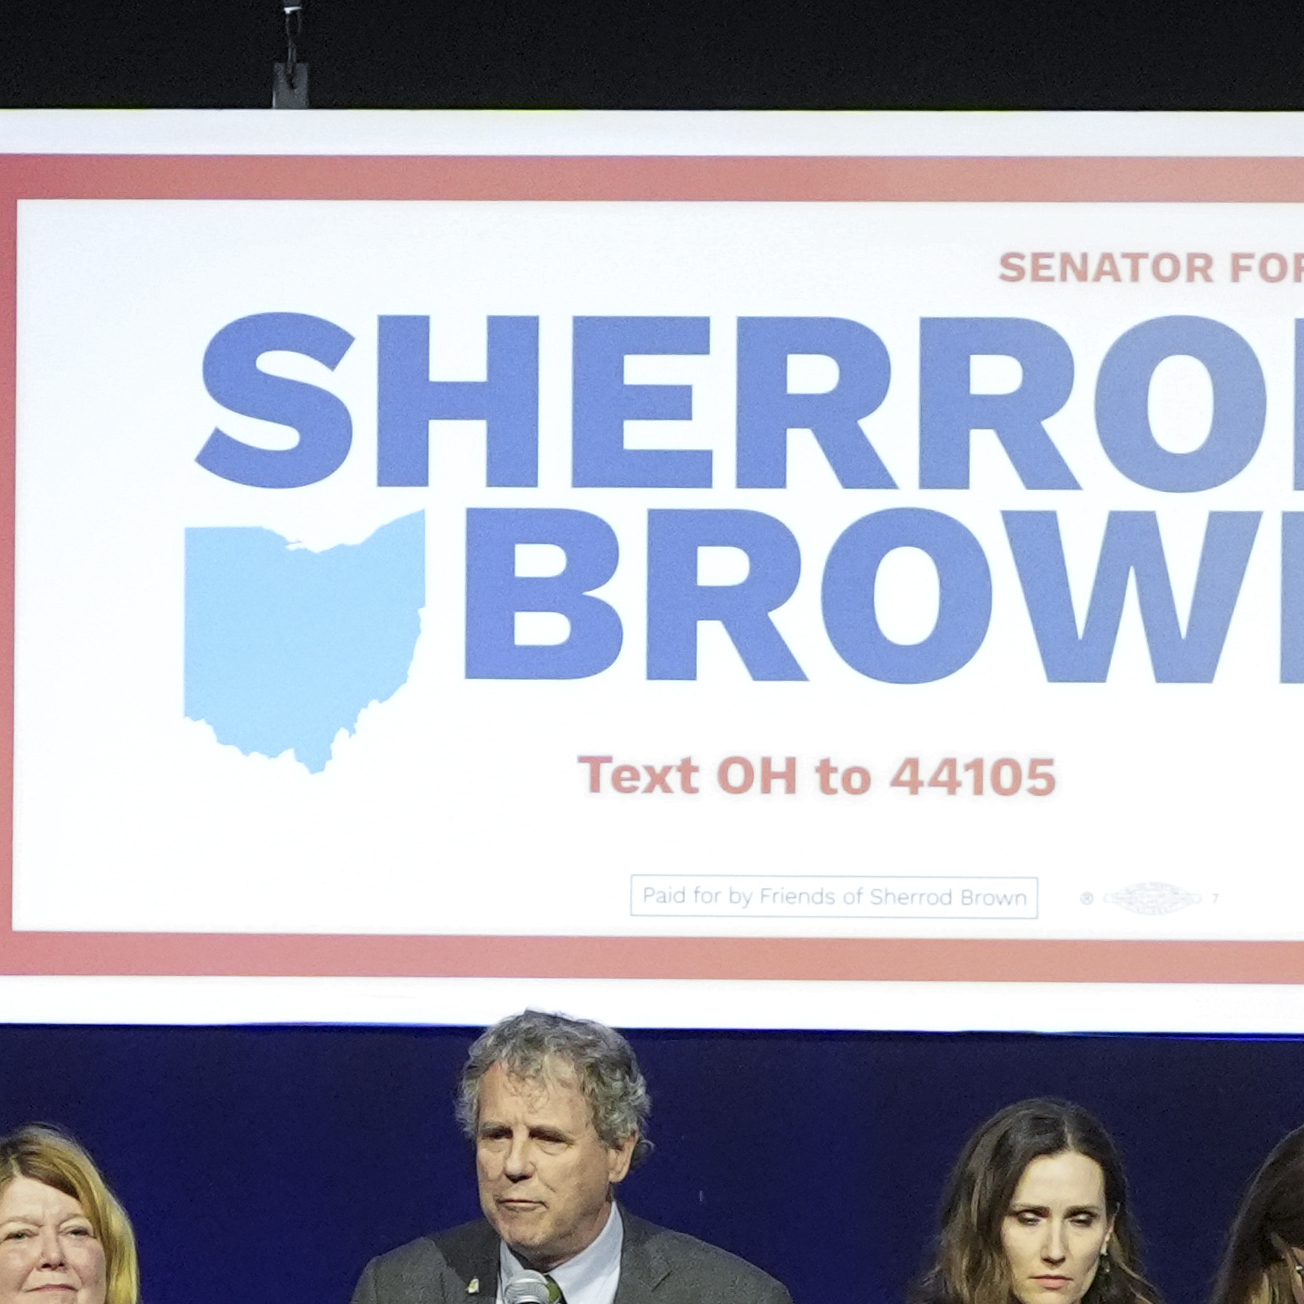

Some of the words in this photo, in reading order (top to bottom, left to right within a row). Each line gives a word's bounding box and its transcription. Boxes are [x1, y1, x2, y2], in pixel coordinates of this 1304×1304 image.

[999, 251, 1213, 283] SENATOR
[577, 756, 700, 795] Text
[716, 755, 797, 795] OH
[814, 757, 872, 796] to
[889, 757, 1057, 797] 44105
[642, 885, 686, 904] Paid
[693, 885, 722, 904] for
[729, 886, 753, 909] by
[760, 886, 836, 905] Friends
[843, 886, 864, 905] of
[870, 887, 952, 907] Sherrod
[961, 888, 1027, 907] Brown
